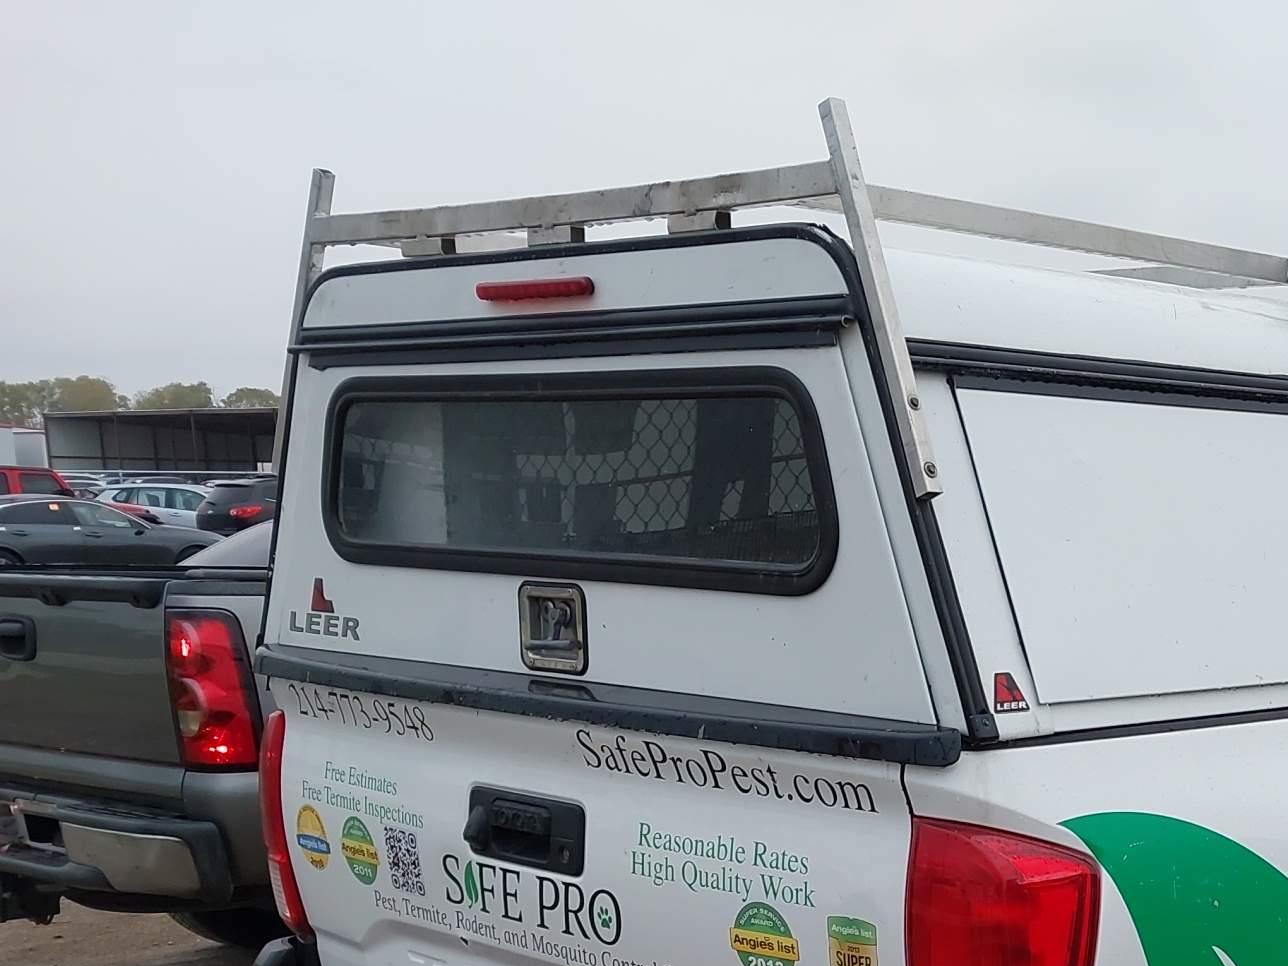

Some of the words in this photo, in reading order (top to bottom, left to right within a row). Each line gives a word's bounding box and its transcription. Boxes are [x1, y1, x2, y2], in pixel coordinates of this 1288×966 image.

[289, 610, 361, 641] LEER
[288, 683, 435, 742] 214-773-9548
[996, 701, 1027, 711] LEER
[324, 761, 346, 785] Free
[348, 766, 398, 796] Estimates
[575, 728, 880, 814] SafeProPest.com
[301, 780, 322, 802] Free
[323, 786, 361, 813] Termite
[364, 795, 424, 829] Inspections
[353, 863, 373, 879] 2011
[638, 822, 747, 865] Reasonable
[752, 841, 810, 876] Rates
[630, 850, 675, 887] High
[681, 860, 753, 903] Quality
[760, 873, 817, 908] Work
[374, 889, 400, 916] Pest,
[402, 897, 452, 930] Termite,
[456, 910, 501, 944] Rodent,
[504, 929, 529, 950] and
[535, 874, 622, 947] PRO
[777, 940, 796, 955] list
